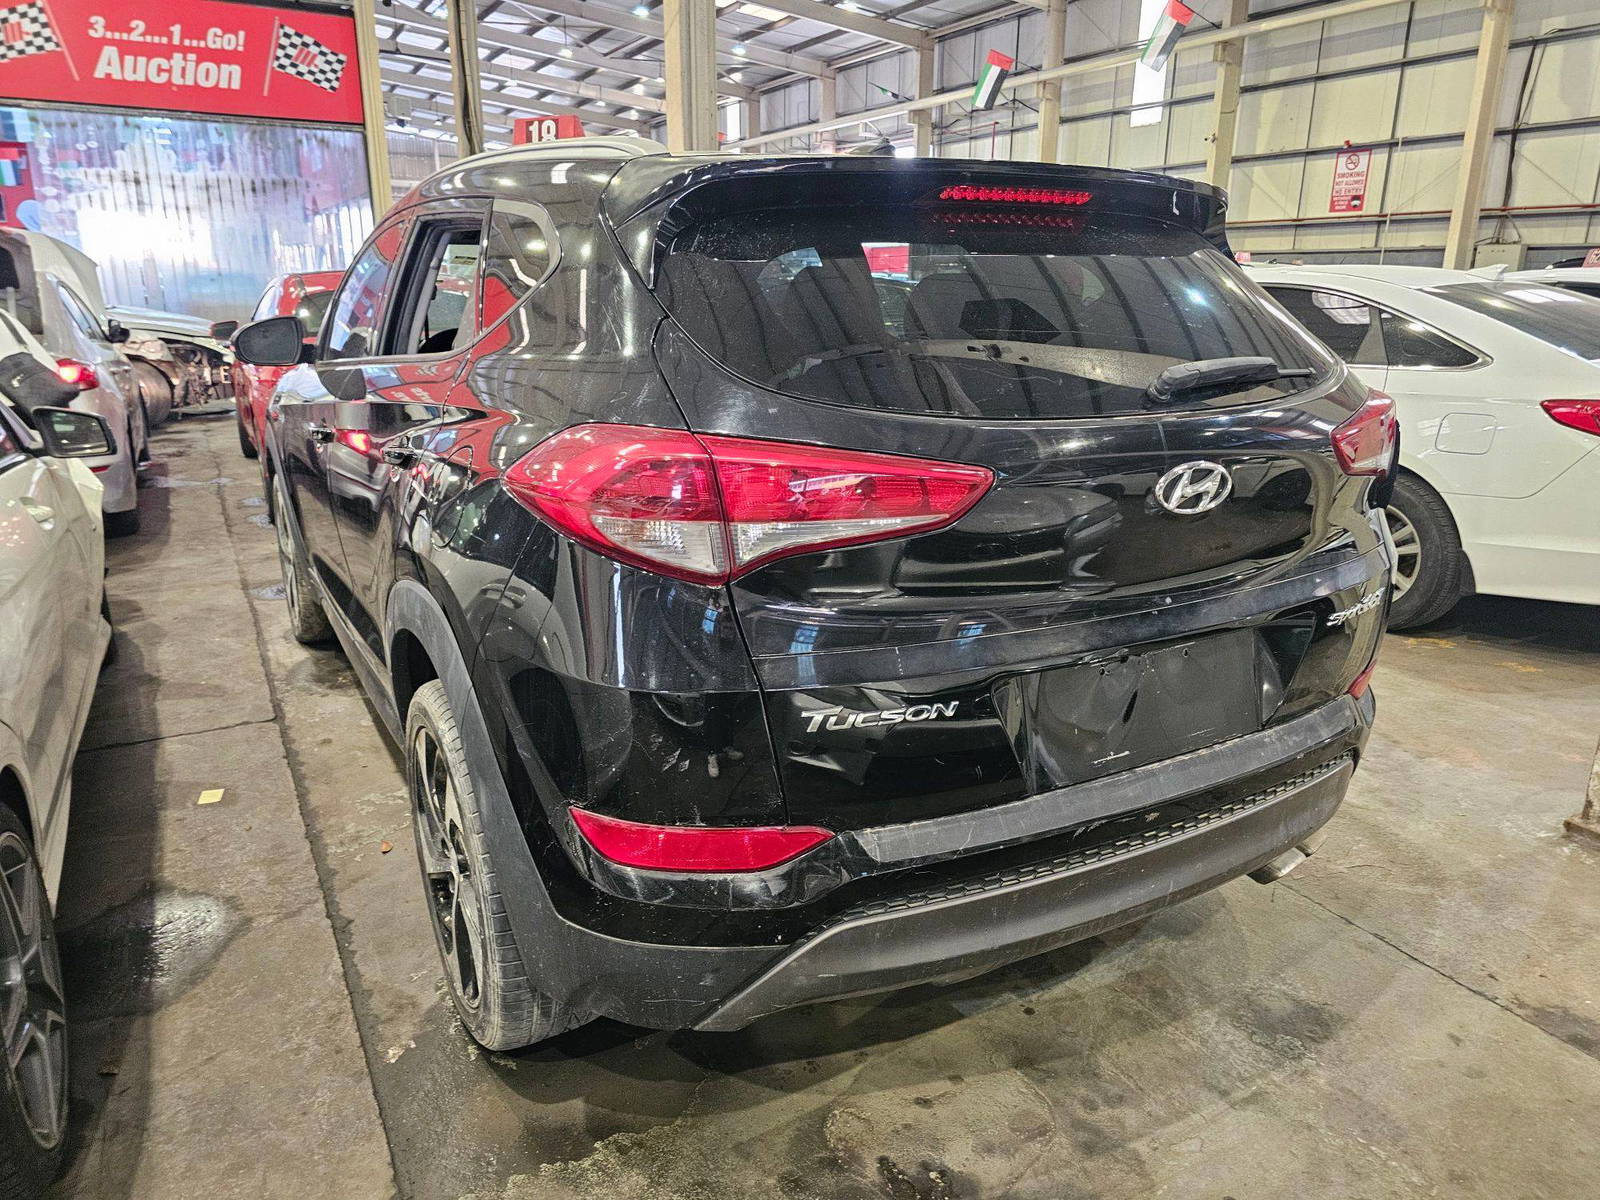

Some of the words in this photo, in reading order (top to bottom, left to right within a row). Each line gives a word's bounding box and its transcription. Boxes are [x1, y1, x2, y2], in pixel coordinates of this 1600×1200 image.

[88, 15, 246, 52] 3...2...1...Go!
[93, 45, 242, 90] Auction
[1337, 170, 1365, 179] SMOKING
[801, 701, 960, 733] TUCSON
